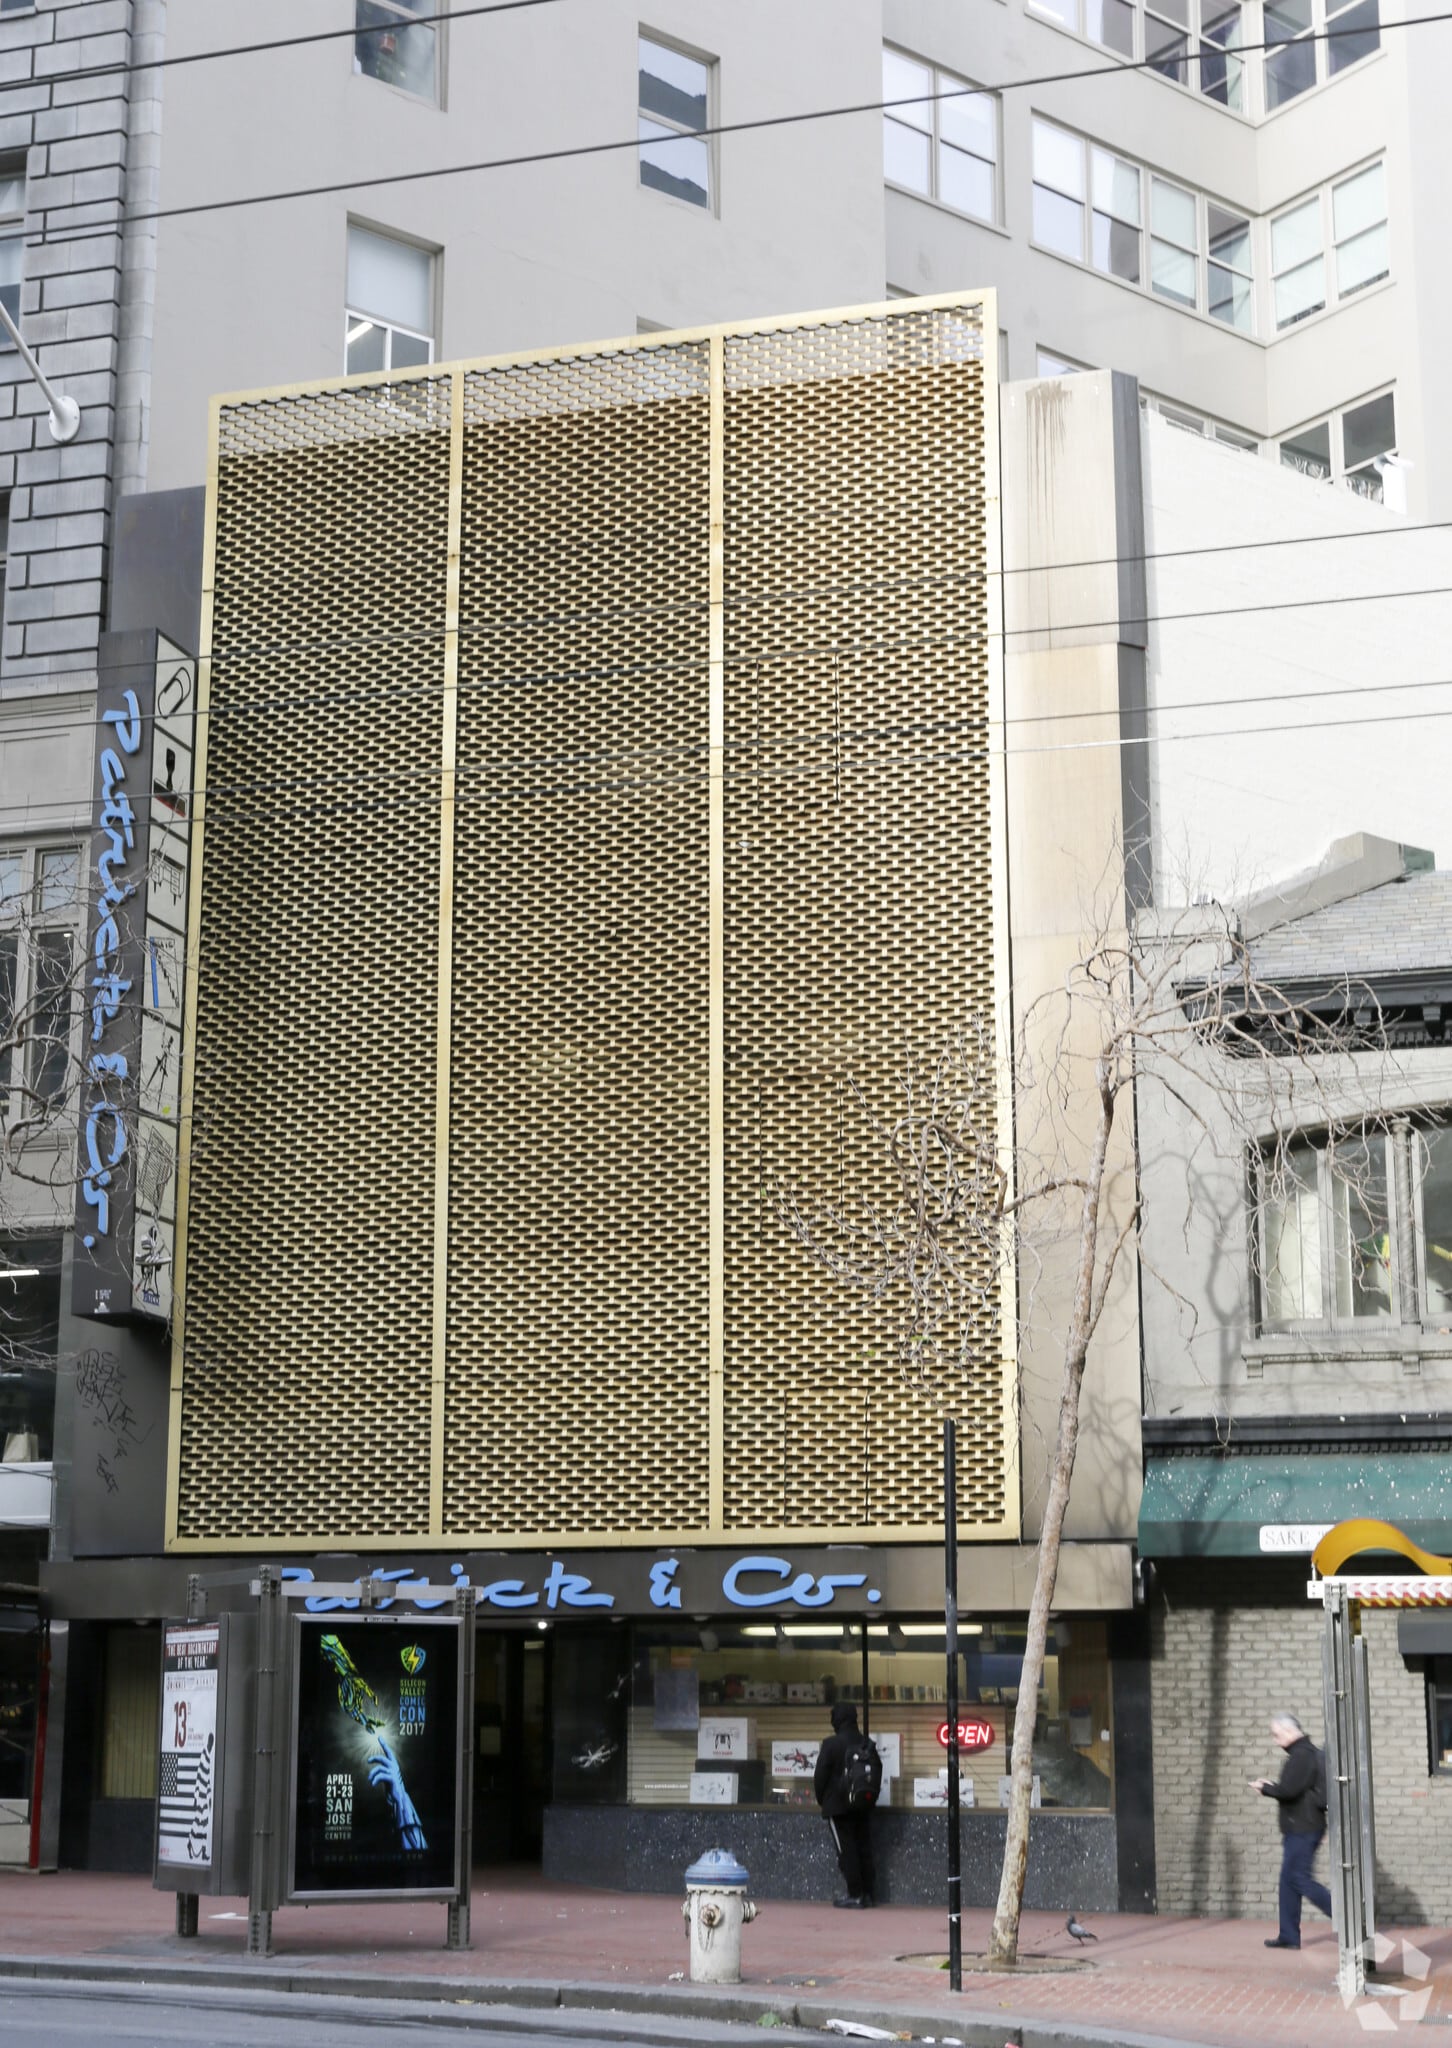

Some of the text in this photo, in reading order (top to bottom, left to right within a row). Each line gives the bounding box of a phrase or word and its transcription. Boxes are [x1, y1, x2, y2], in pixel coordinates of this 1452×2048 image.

[93, 689, 142, 1041] Patrick
[1265, 1531, 1310, 1545] SAKE
[649, 1557, 682, 1608] &
[722, 1556, 881, 1607] Co.
[400, 1687, 426, 1696] VALLEY
[399, 1696, 426, 1706] COMIC
[399, 1706, 426, 1721] CON
[173, 1701, 187, 1748] 13
[399, 1722, 425, 1736] 2017
[939, 1725, 990, 1744] OPEN
[326, 1774, 353, 1785] APRIL
[326, 1785, 353, 1798] 21-23
[326, 1798, 353, 1812] SAN
[325, 1813, 352, 1825] JOSE
[325, 1832, 352, 1840] CENTER
